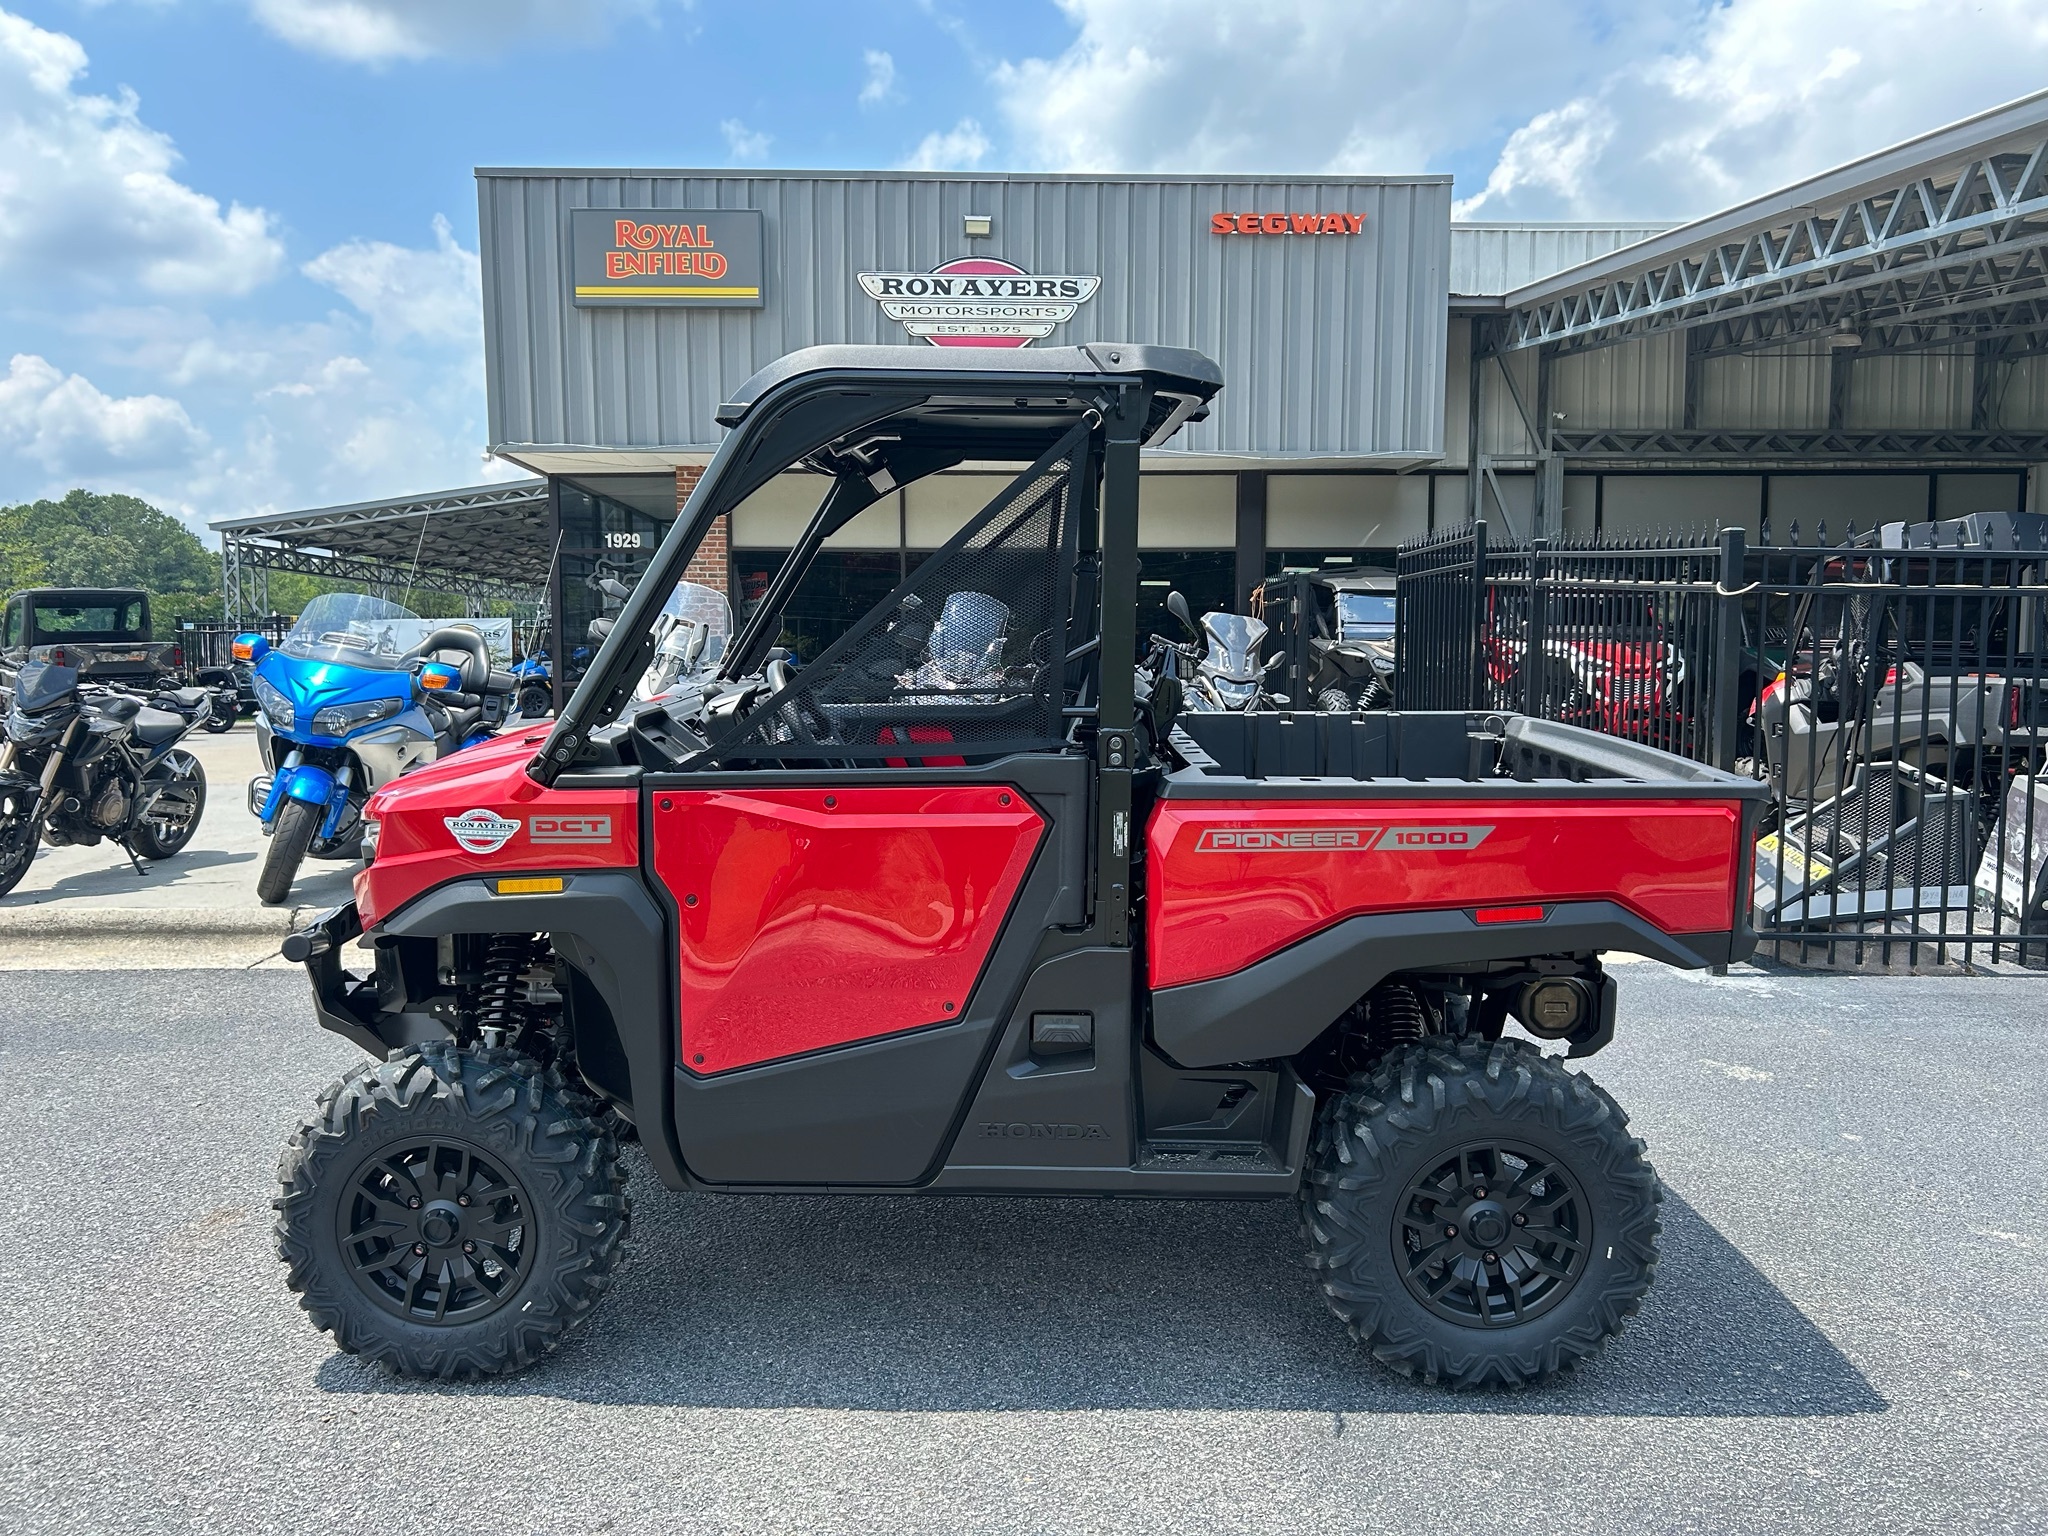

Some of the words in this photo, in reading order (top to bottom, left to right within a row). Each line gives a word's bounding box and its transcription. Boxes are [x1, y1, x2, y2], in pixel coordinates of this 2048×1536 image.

[1211, 213, 1367, 234] SEGWAY
[615, 220, 714, 250] ROYAL
[606, 252, 727, 279] ENFIELD
[879, 278, 955, 296] RON
[959, 279, 1080, 298] AYERS
[900, 306, 1058, 317] MOTORSPORTS
[937, 325, 971, 333] EST.
[981, 325, 1021, 333] 1975
[605, 533, 640, 548] 1929
[535, 820, 605, 832] DCT
[1212, 832, 1359, 848] PIONEER
[1396, 832, 1468, 844] 1000
[978, 1122, 1111, 1140] HONDA
